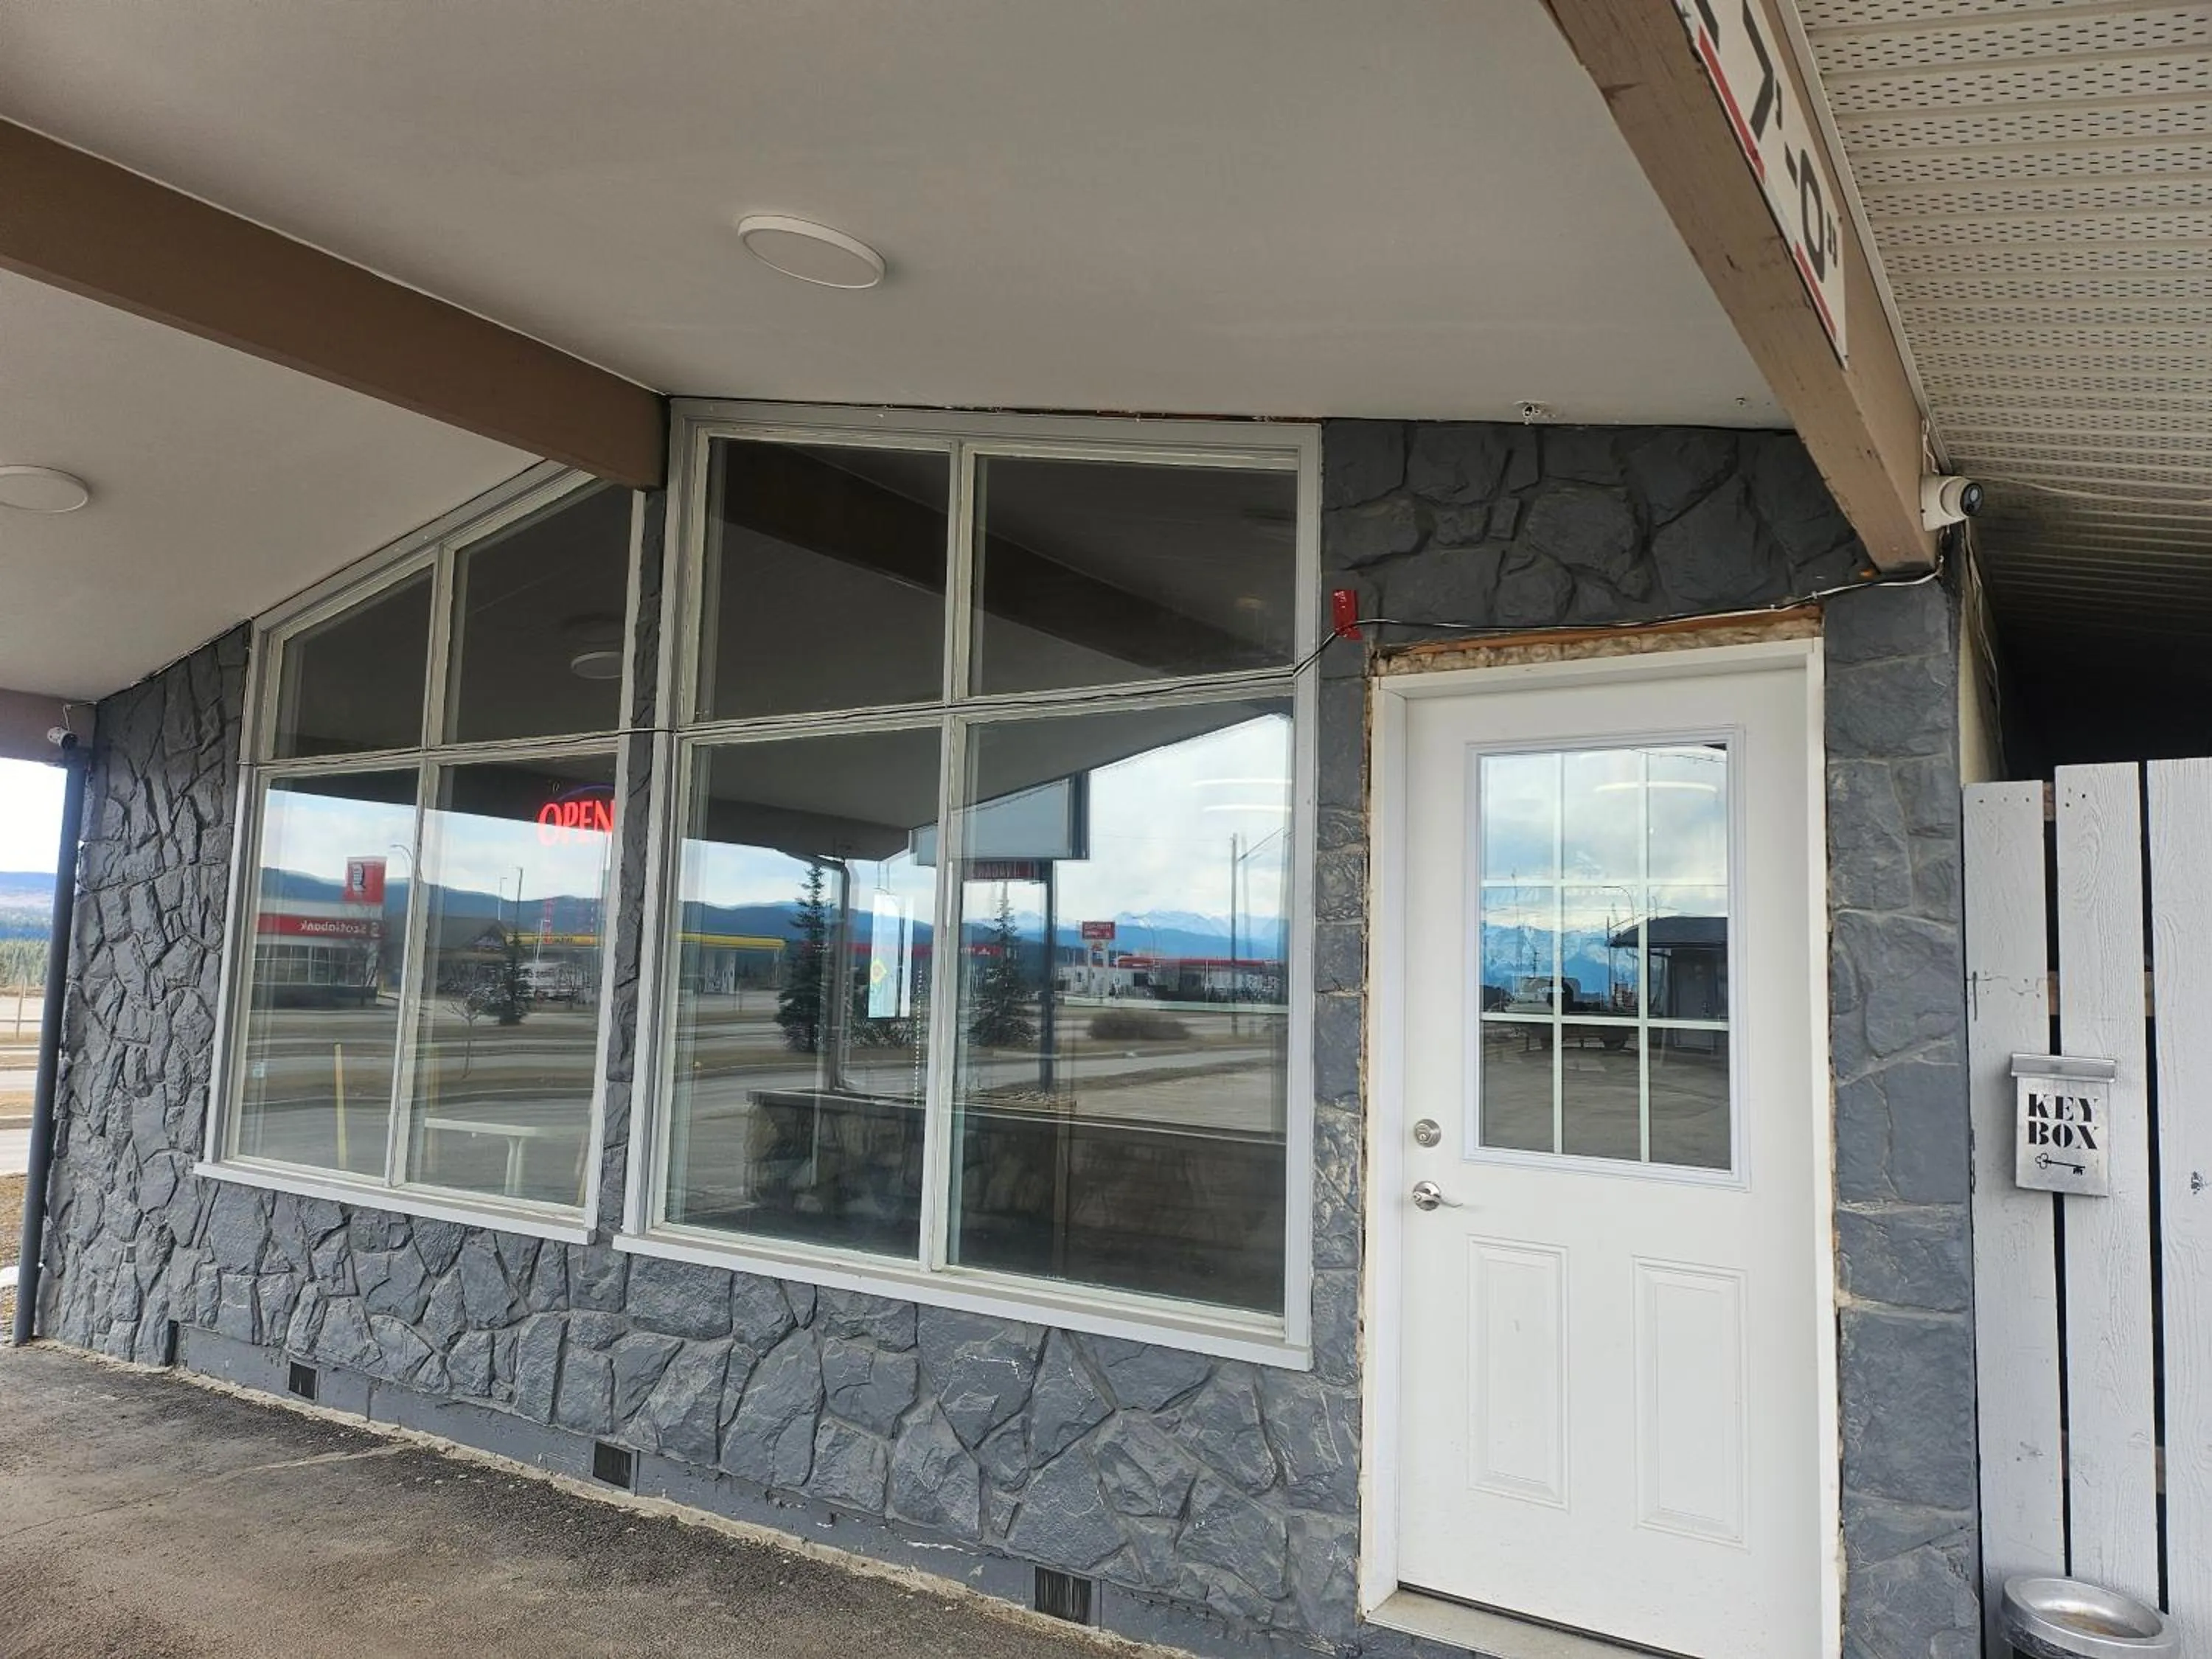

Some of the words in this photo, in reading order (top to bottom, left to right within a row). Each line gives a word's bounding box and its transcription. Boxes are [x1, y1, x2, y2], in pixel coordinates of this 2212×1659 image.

[537, 800, 615, 847] OPEN
[2028, 1093, 2100, 1122] KEY
[2028, 1121, 2100, 1150] BOX
